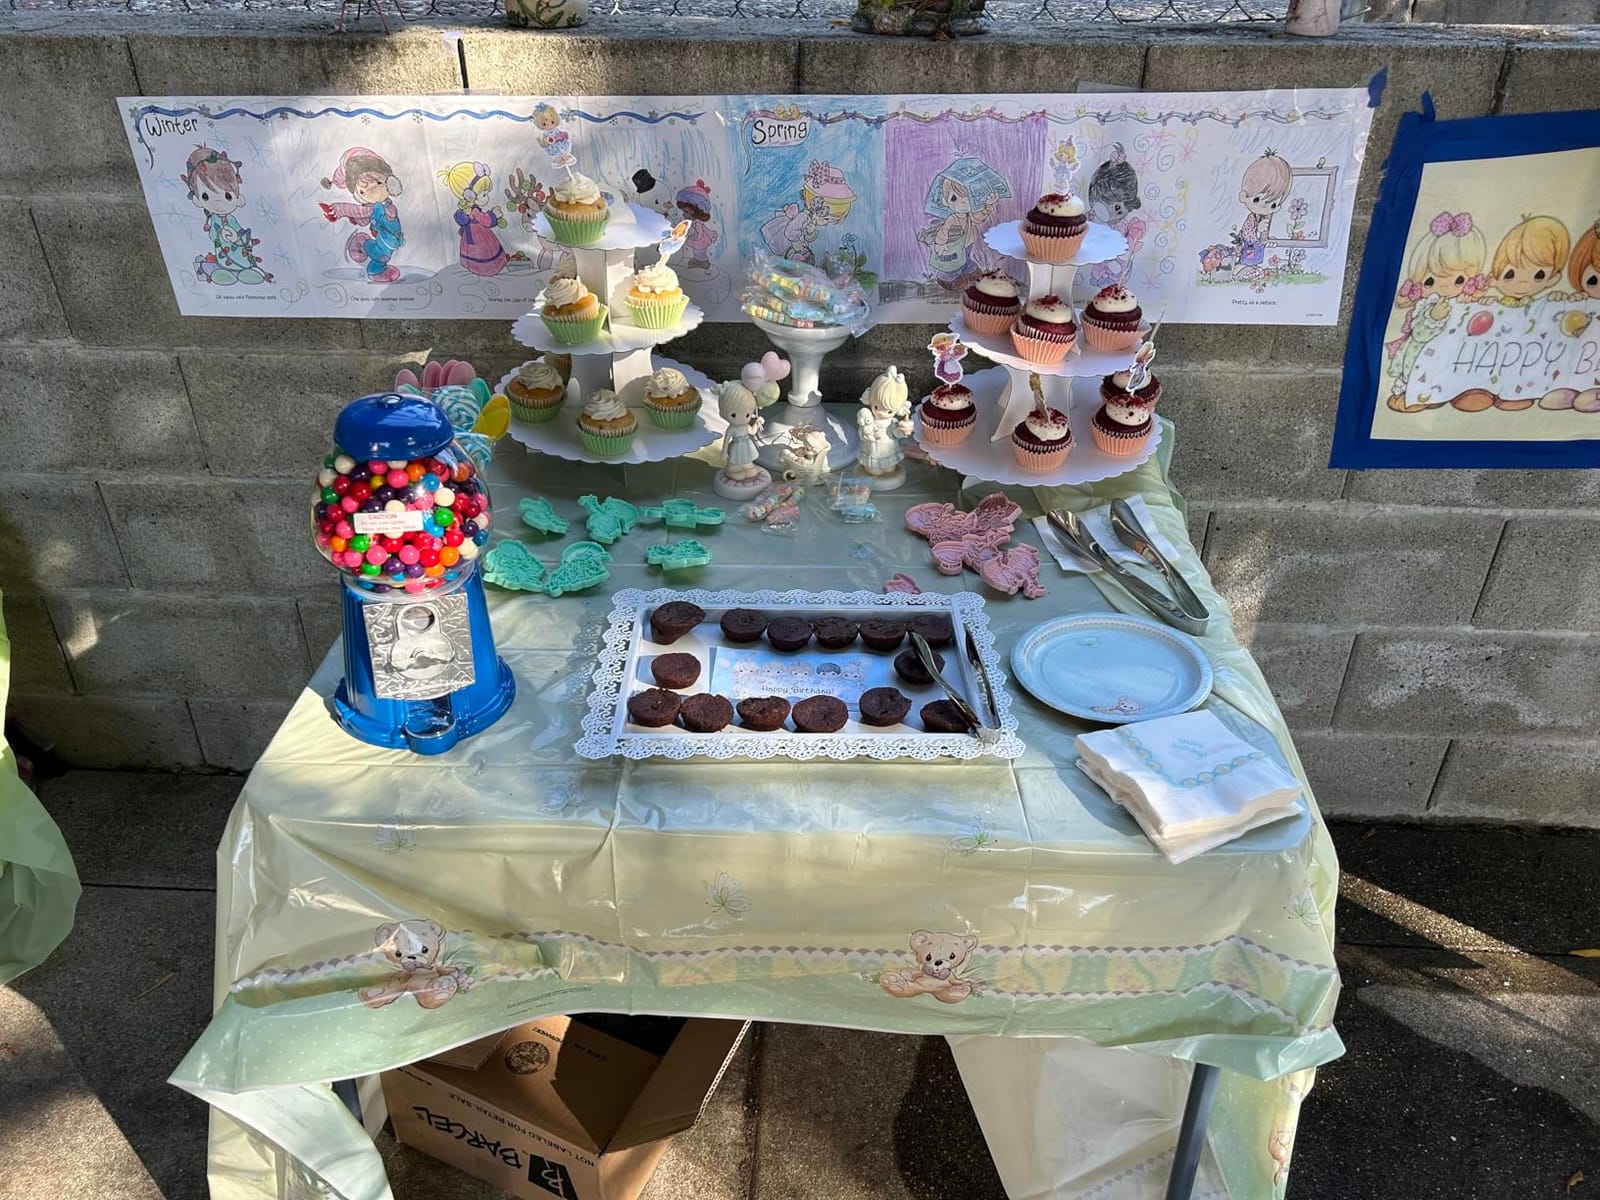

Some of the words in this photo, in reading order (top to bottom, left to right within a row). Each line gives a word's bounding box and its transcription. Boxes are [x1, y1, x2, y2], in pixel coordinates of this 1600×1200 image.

[144, 116, 198, 137] Winter
[751, 119, 808, 145] Spring
[1452, 340, 1567, 377] HAPPY
[761, 685, 788, 694] Happy
[448, 1092, 472, 1108] SALE
[475, 1105, 505, 1124] RETAIL
[412, 1105, 522, 1169] BARCEL
[507, 1121, 527, 1135] FOR
[528, 1131, 573, 1156] LABELED
[575, 1154, 595, 1167] NOT
